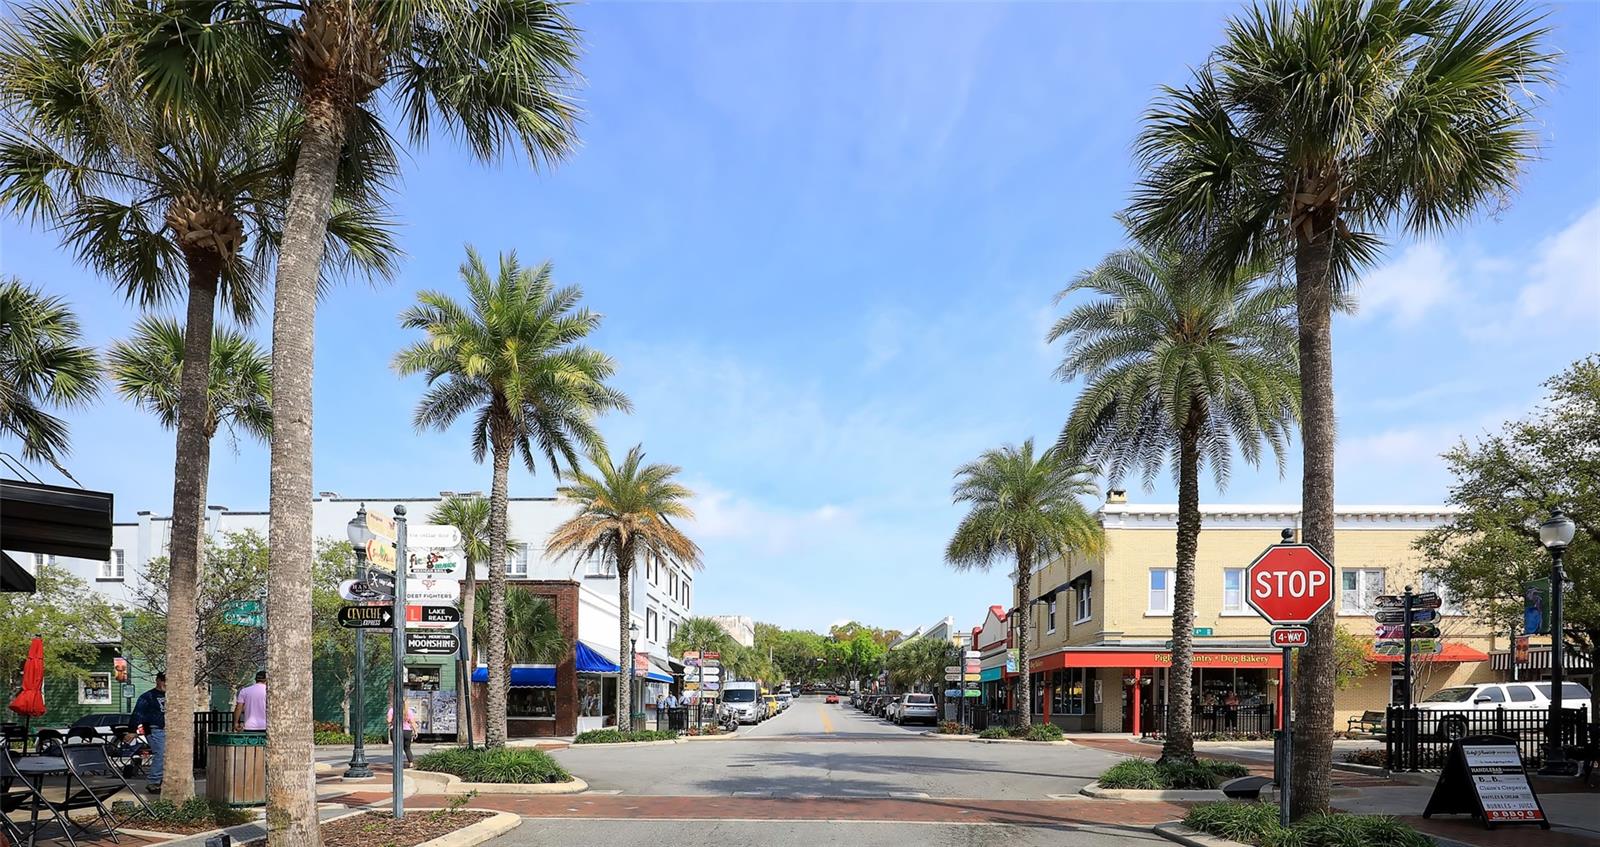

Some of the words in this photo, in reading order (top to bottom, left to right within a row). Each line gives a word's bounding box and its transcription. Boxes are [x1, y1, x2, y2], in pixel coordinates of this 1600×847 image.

[1255, 570, 1326, 598] STOP
[347, 607, 382, 619] CEVICHE
[410, 608, 418, 620] L
[1278, 632, 1302, 642] 4-WAY
[408, 640, 456, 648] MOONSHINE
[1221, 655, 1239, 663] Dog
[1241, 655, 1269, 664] Bakery
